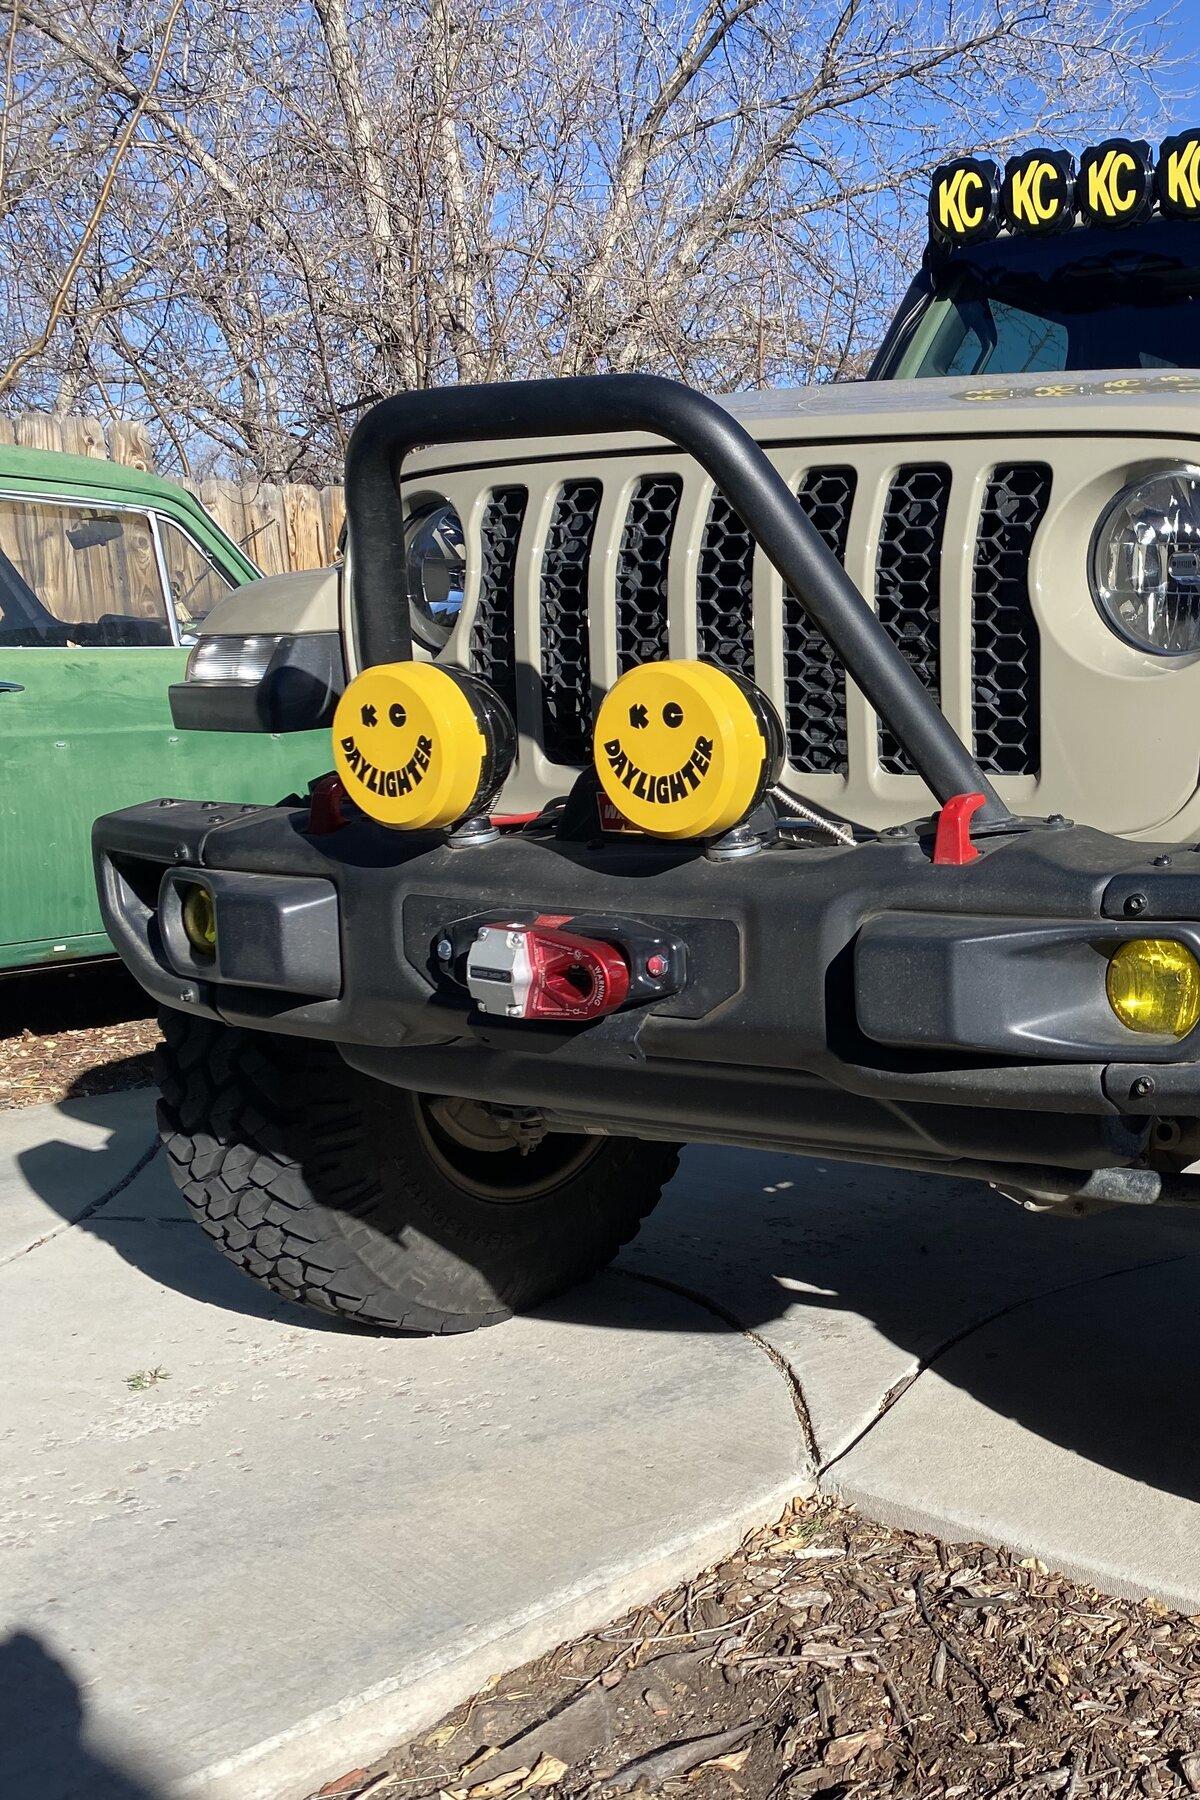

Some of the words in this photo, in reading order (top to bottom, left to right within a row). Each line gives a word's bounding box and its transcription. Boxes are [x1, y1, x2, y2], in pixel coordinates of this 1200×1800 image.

[939, 171, 983, 233] KC
[1012, 161, 1058, 225] KC
[1088, 151, 1137, 217] KC
[340, 734, 433, 798] DAYLIGHTER
[603, 735, 714, 804] DAYLIGHTER
[593, 965, 605, 1006] WARNING
